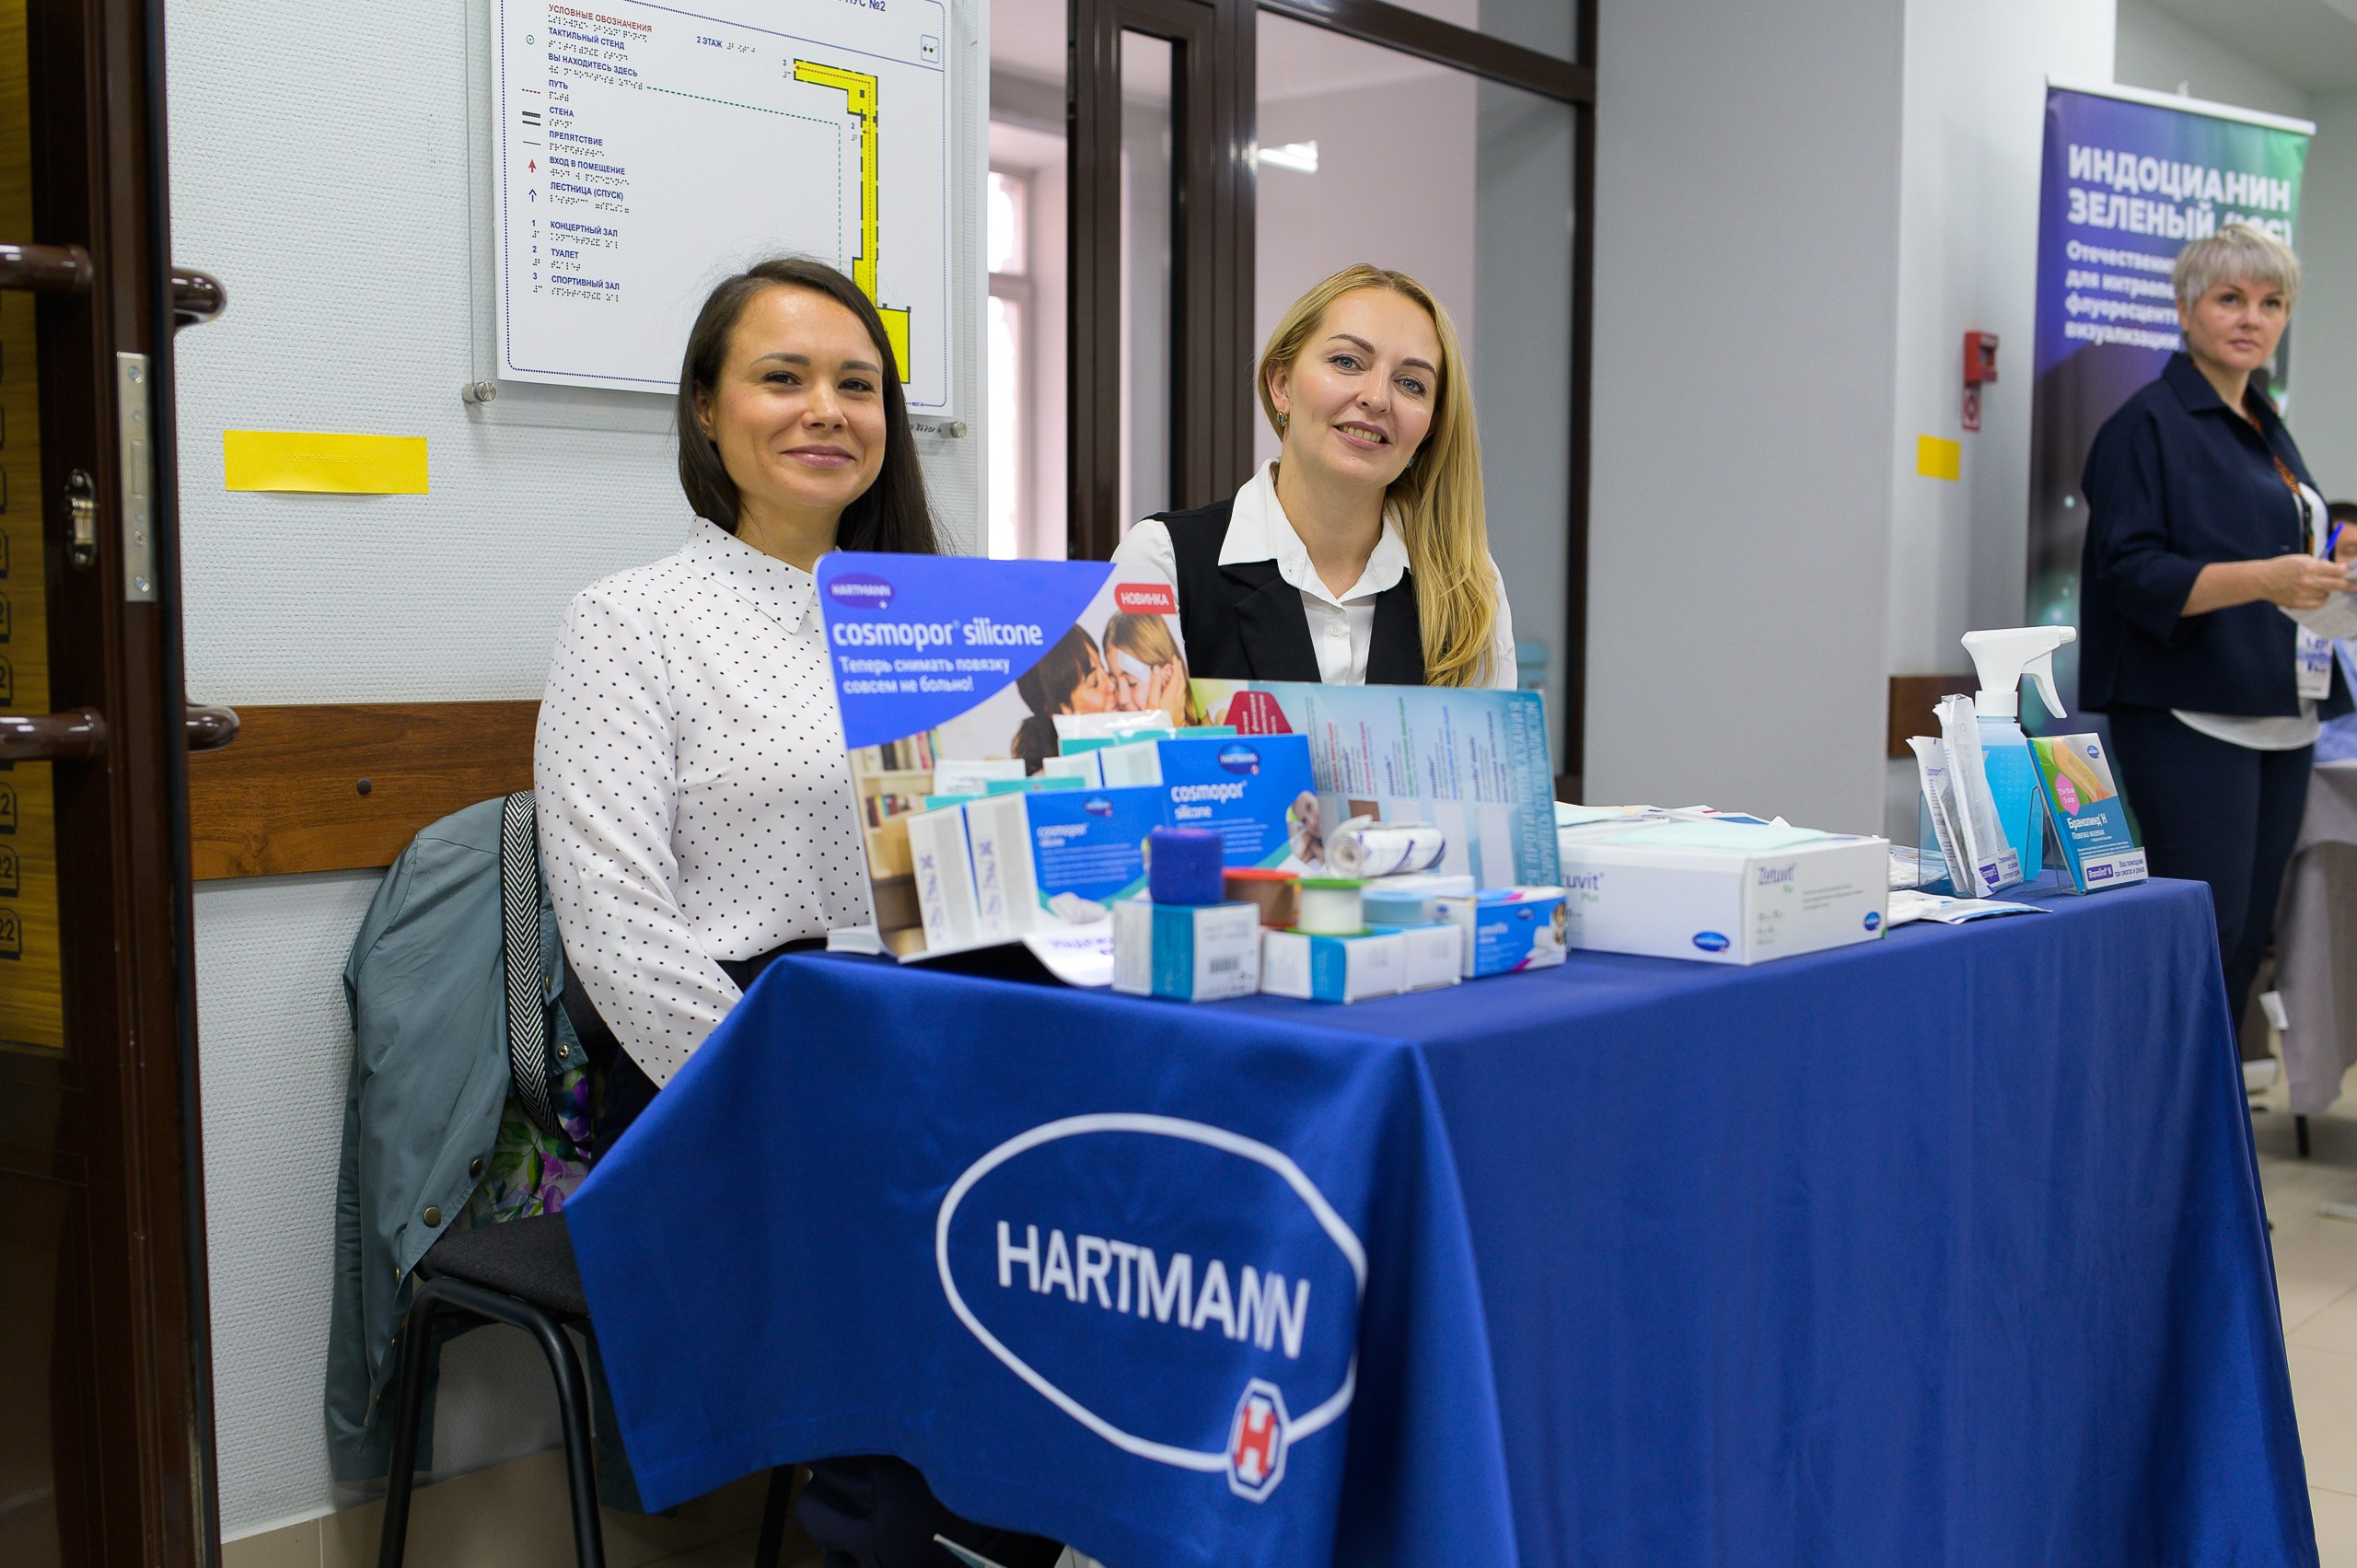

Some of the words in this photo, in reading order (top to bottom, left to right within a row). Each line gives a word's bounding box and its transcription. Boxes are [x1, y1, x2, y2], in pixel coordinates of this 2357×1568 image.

[549, 4, 593, 21] УСЛОВНЫЕ
[596, 14, 653, 33] ОБОЗНАЧЕНИЯ
[549, 27, 598, 44] ТАКТИЛЬНЫЙ
[600, 38, 625, 50] СТЕНД
[702, 37, 723, 48] ЭТАЖ
[548, 52, 561, 63] ВЫ
[562, 55, 612, 72] НАХОДИТЕСЬ
[613, 65, 638, 77] ЗДЕСЬ
[549, 79, 568, 89] ПУТЬ
[549, 107, 575, 118] СТЕНА
[549, 130, 603, 146] ПРЕПЯТСТВИЕ
[550, 157, 569, 167] ВХОД
[571, 158, 576, 168] В
[577, 160, 626, 176] ПОМЕЩЕНИЕ
[2068, 143, 2291, 212] ИНДОЦИАНИН
[551, 181, 592, 196] ЛЕСТНИЦА
[593, 188, 624, 202] (СПУСК)
[2067, 189, 2215, 239] ЗЕЛЕНЫЙ
[531, 219, 536, 227] 1
[551, 220, 602, 235] КОНЦЕРТНЫЙ
[603, 227, 618, 238] ЗАЛ
[532, 245, 537, 253] 2
[551, 248, 579, 259] ТУАЛЕТ
[532, 272, 538, 280] 3
[551, 274, 604, 289] СПОРТИВНЫЙ
[605, 281, 620, 291] ЗАЛ
[1121, 591, 1170, 607] НОВИНКА
[962, 617, 1044, 645] silicone
[838, 656, 892, 677] Теперь
[894, 658, 954, 673] снимать
[955, 657, 1010, 676] повязку
[842, 679, 899, 694] совсем
[900, 679, 918, 693] не
[919, 675, 975, 693] больно!
[997, 1220, 1310, 1360] HARTMANN
